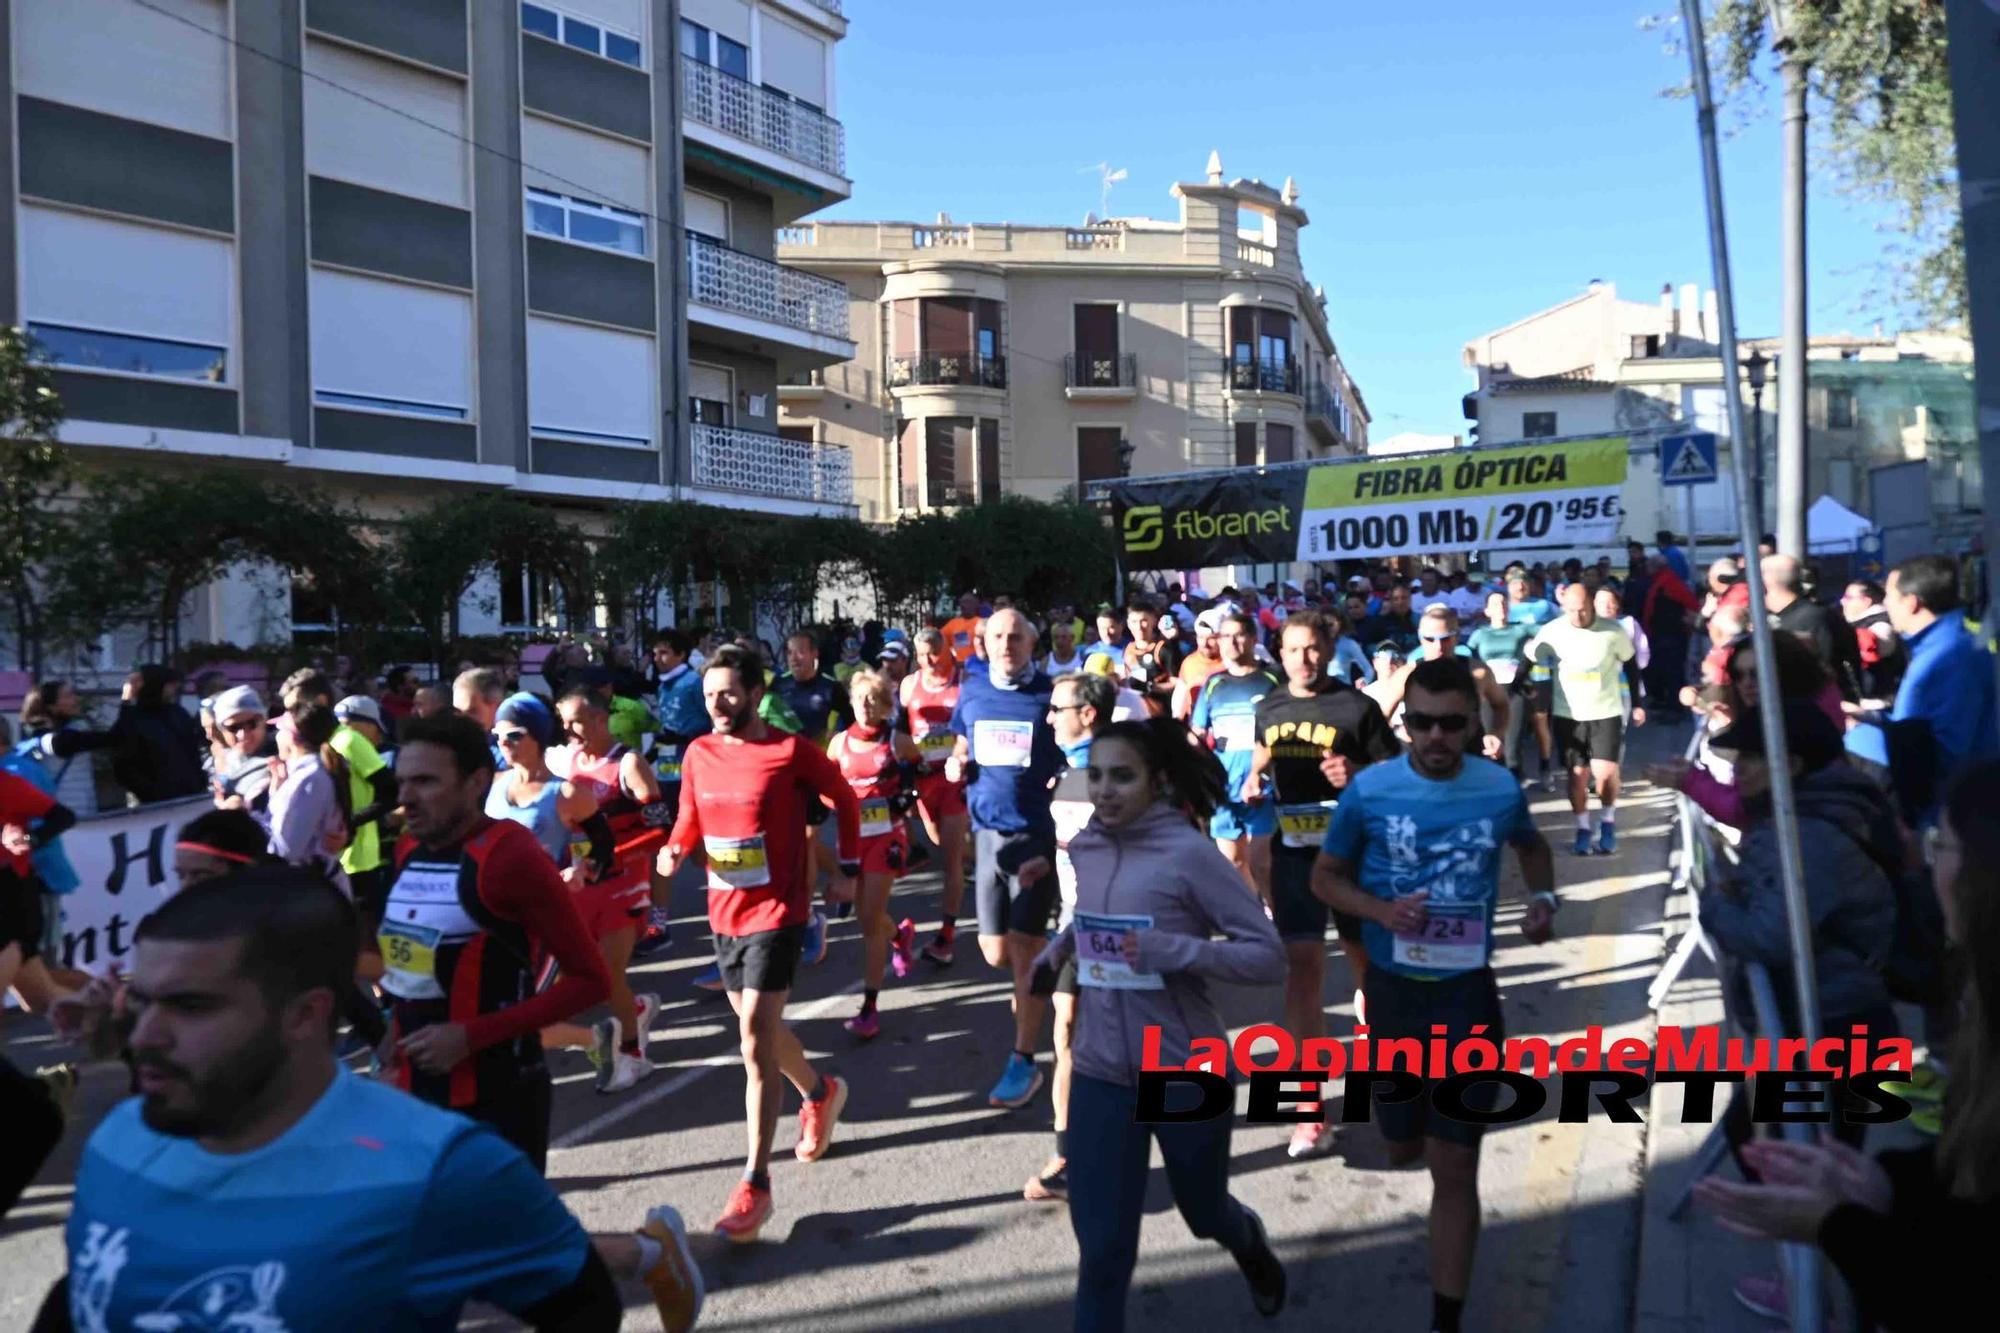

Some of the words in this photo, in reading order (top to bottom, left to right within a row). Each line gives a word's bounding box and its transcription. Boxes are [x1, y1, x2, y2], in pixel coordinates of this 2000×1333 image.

[1355, 464, 1443, 499] FIBRA
[1455, 453, 1568, 490] ÓPTICA
[1173, 504, 1291, 540] fibranet
[1320, 514, 1409, 552] 1000
[1419, 508, 1479, 546] Mb
[389, 938, 412, 963] 56
[1090, 933, 1124, 955] 64
